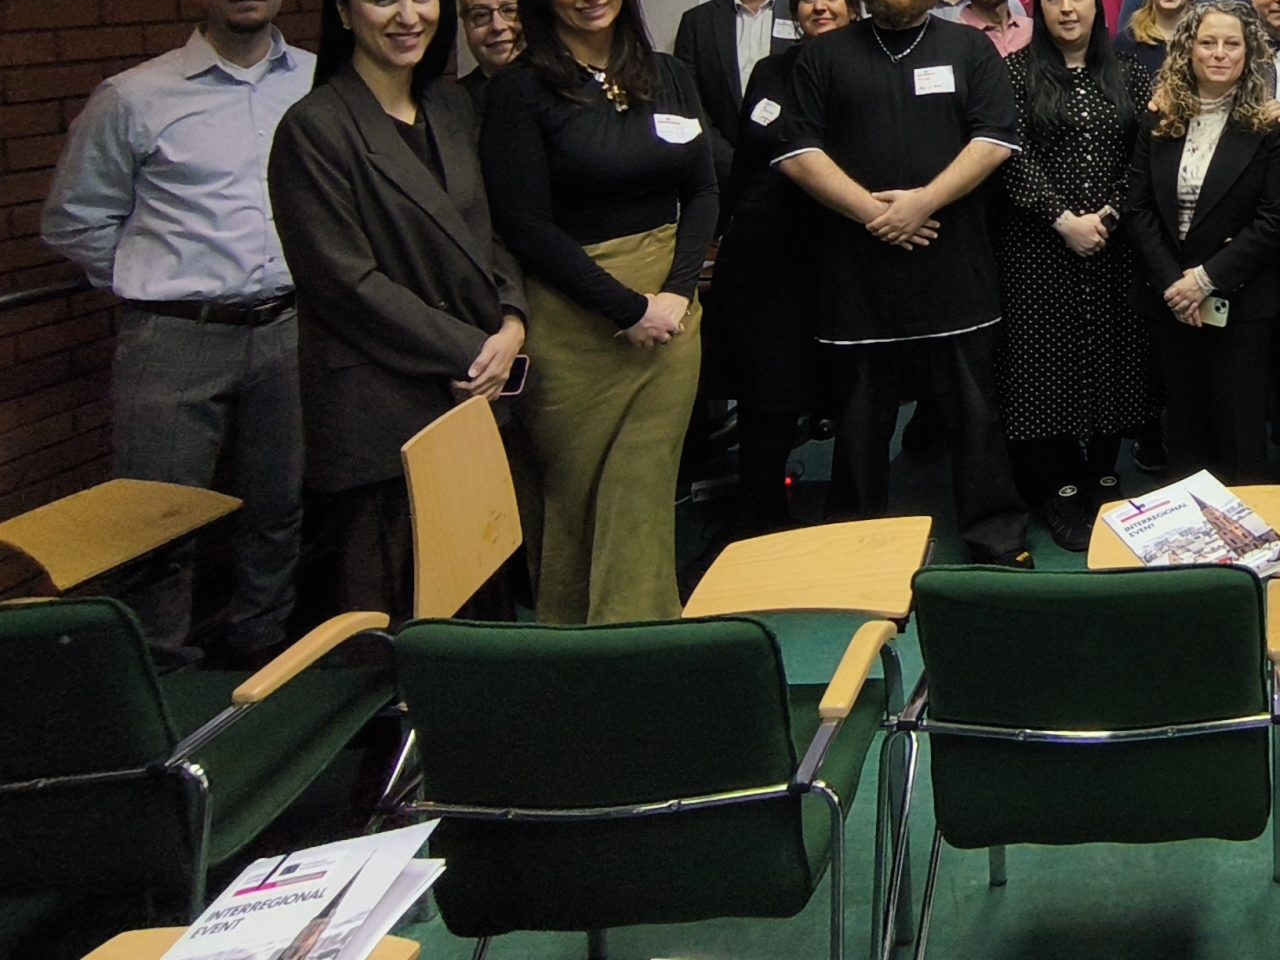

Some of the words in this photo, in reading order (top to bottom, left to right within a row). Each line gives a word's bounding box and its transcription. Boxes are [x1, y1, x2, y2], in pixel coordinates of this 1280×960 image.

[1124, 502, 1189, 534] INTERREGIONAL
[1128, 522, 1157, 538] EVENT
[204, 887, 329, 924] INTERREGIONAL
[190, 917, 247, 940] EVENT
